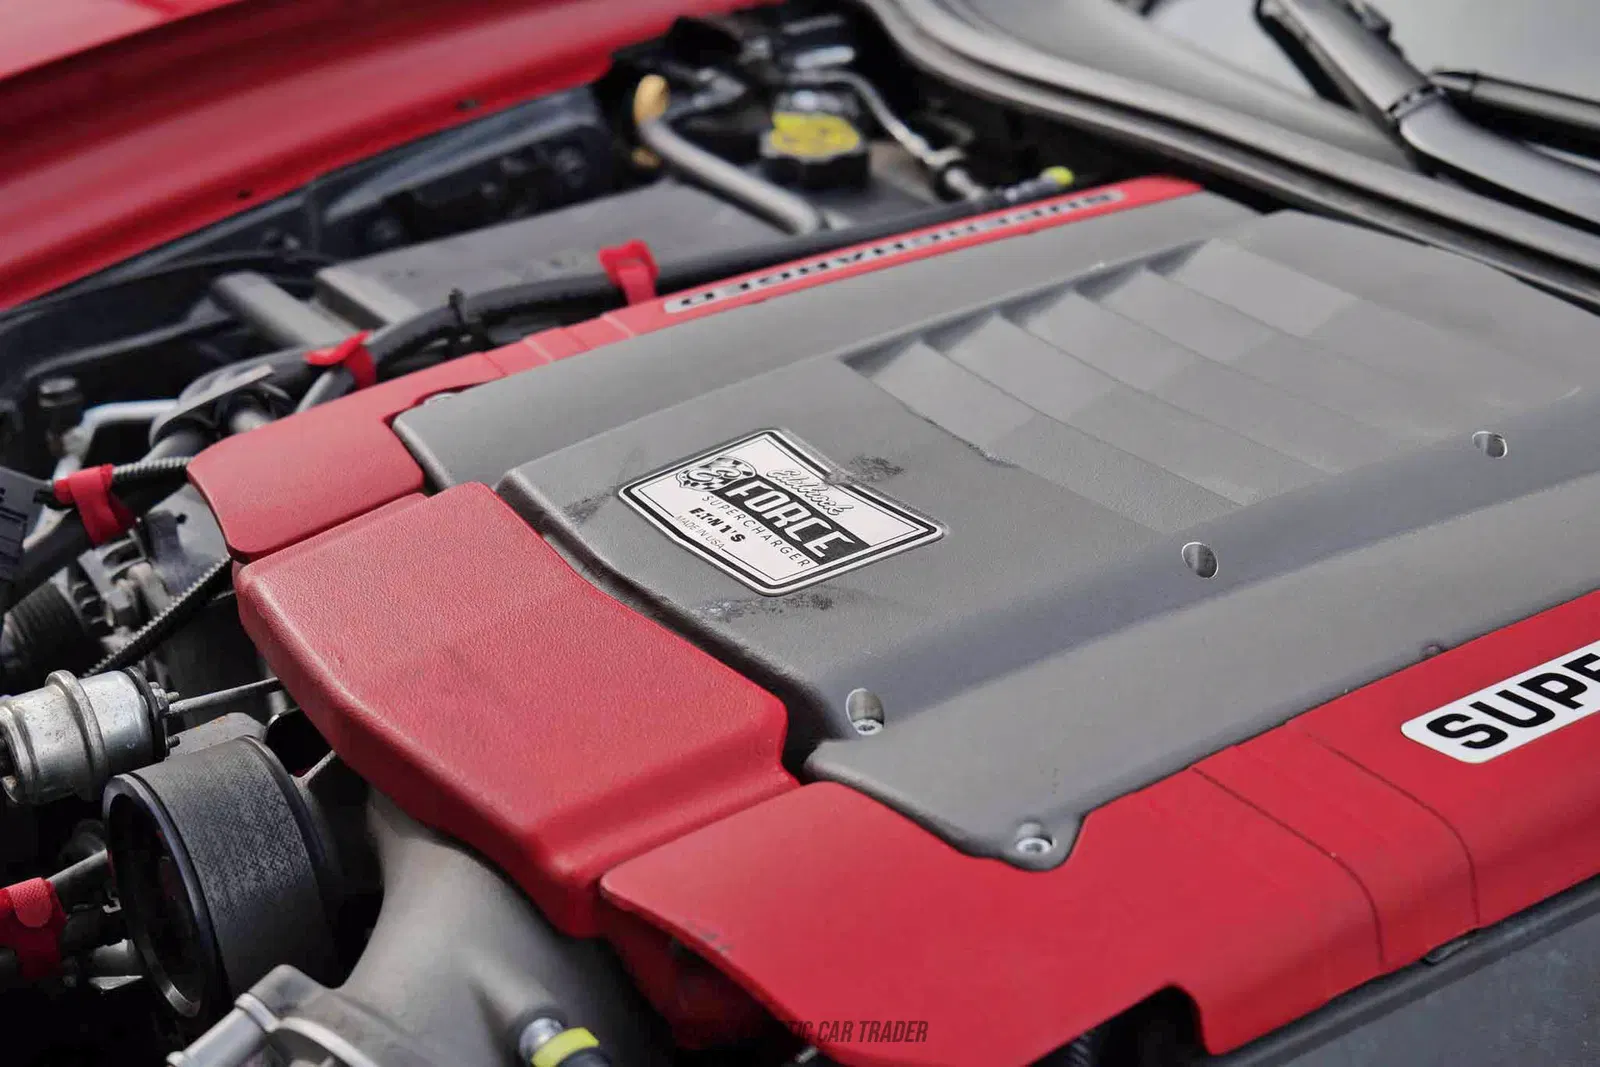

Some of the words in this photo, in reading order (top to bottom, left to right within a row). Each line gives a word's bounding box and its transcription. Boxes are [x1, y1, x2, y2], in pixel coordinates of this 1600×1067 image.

[724, 480, 856, 558] FORCE
[766, 469, 855, 516] Edelbrock
[675, 515, 699, 531] MADE
[706, 532, 725, 549] USA
[702, 495, 810, 567] SUPERCHARGER
